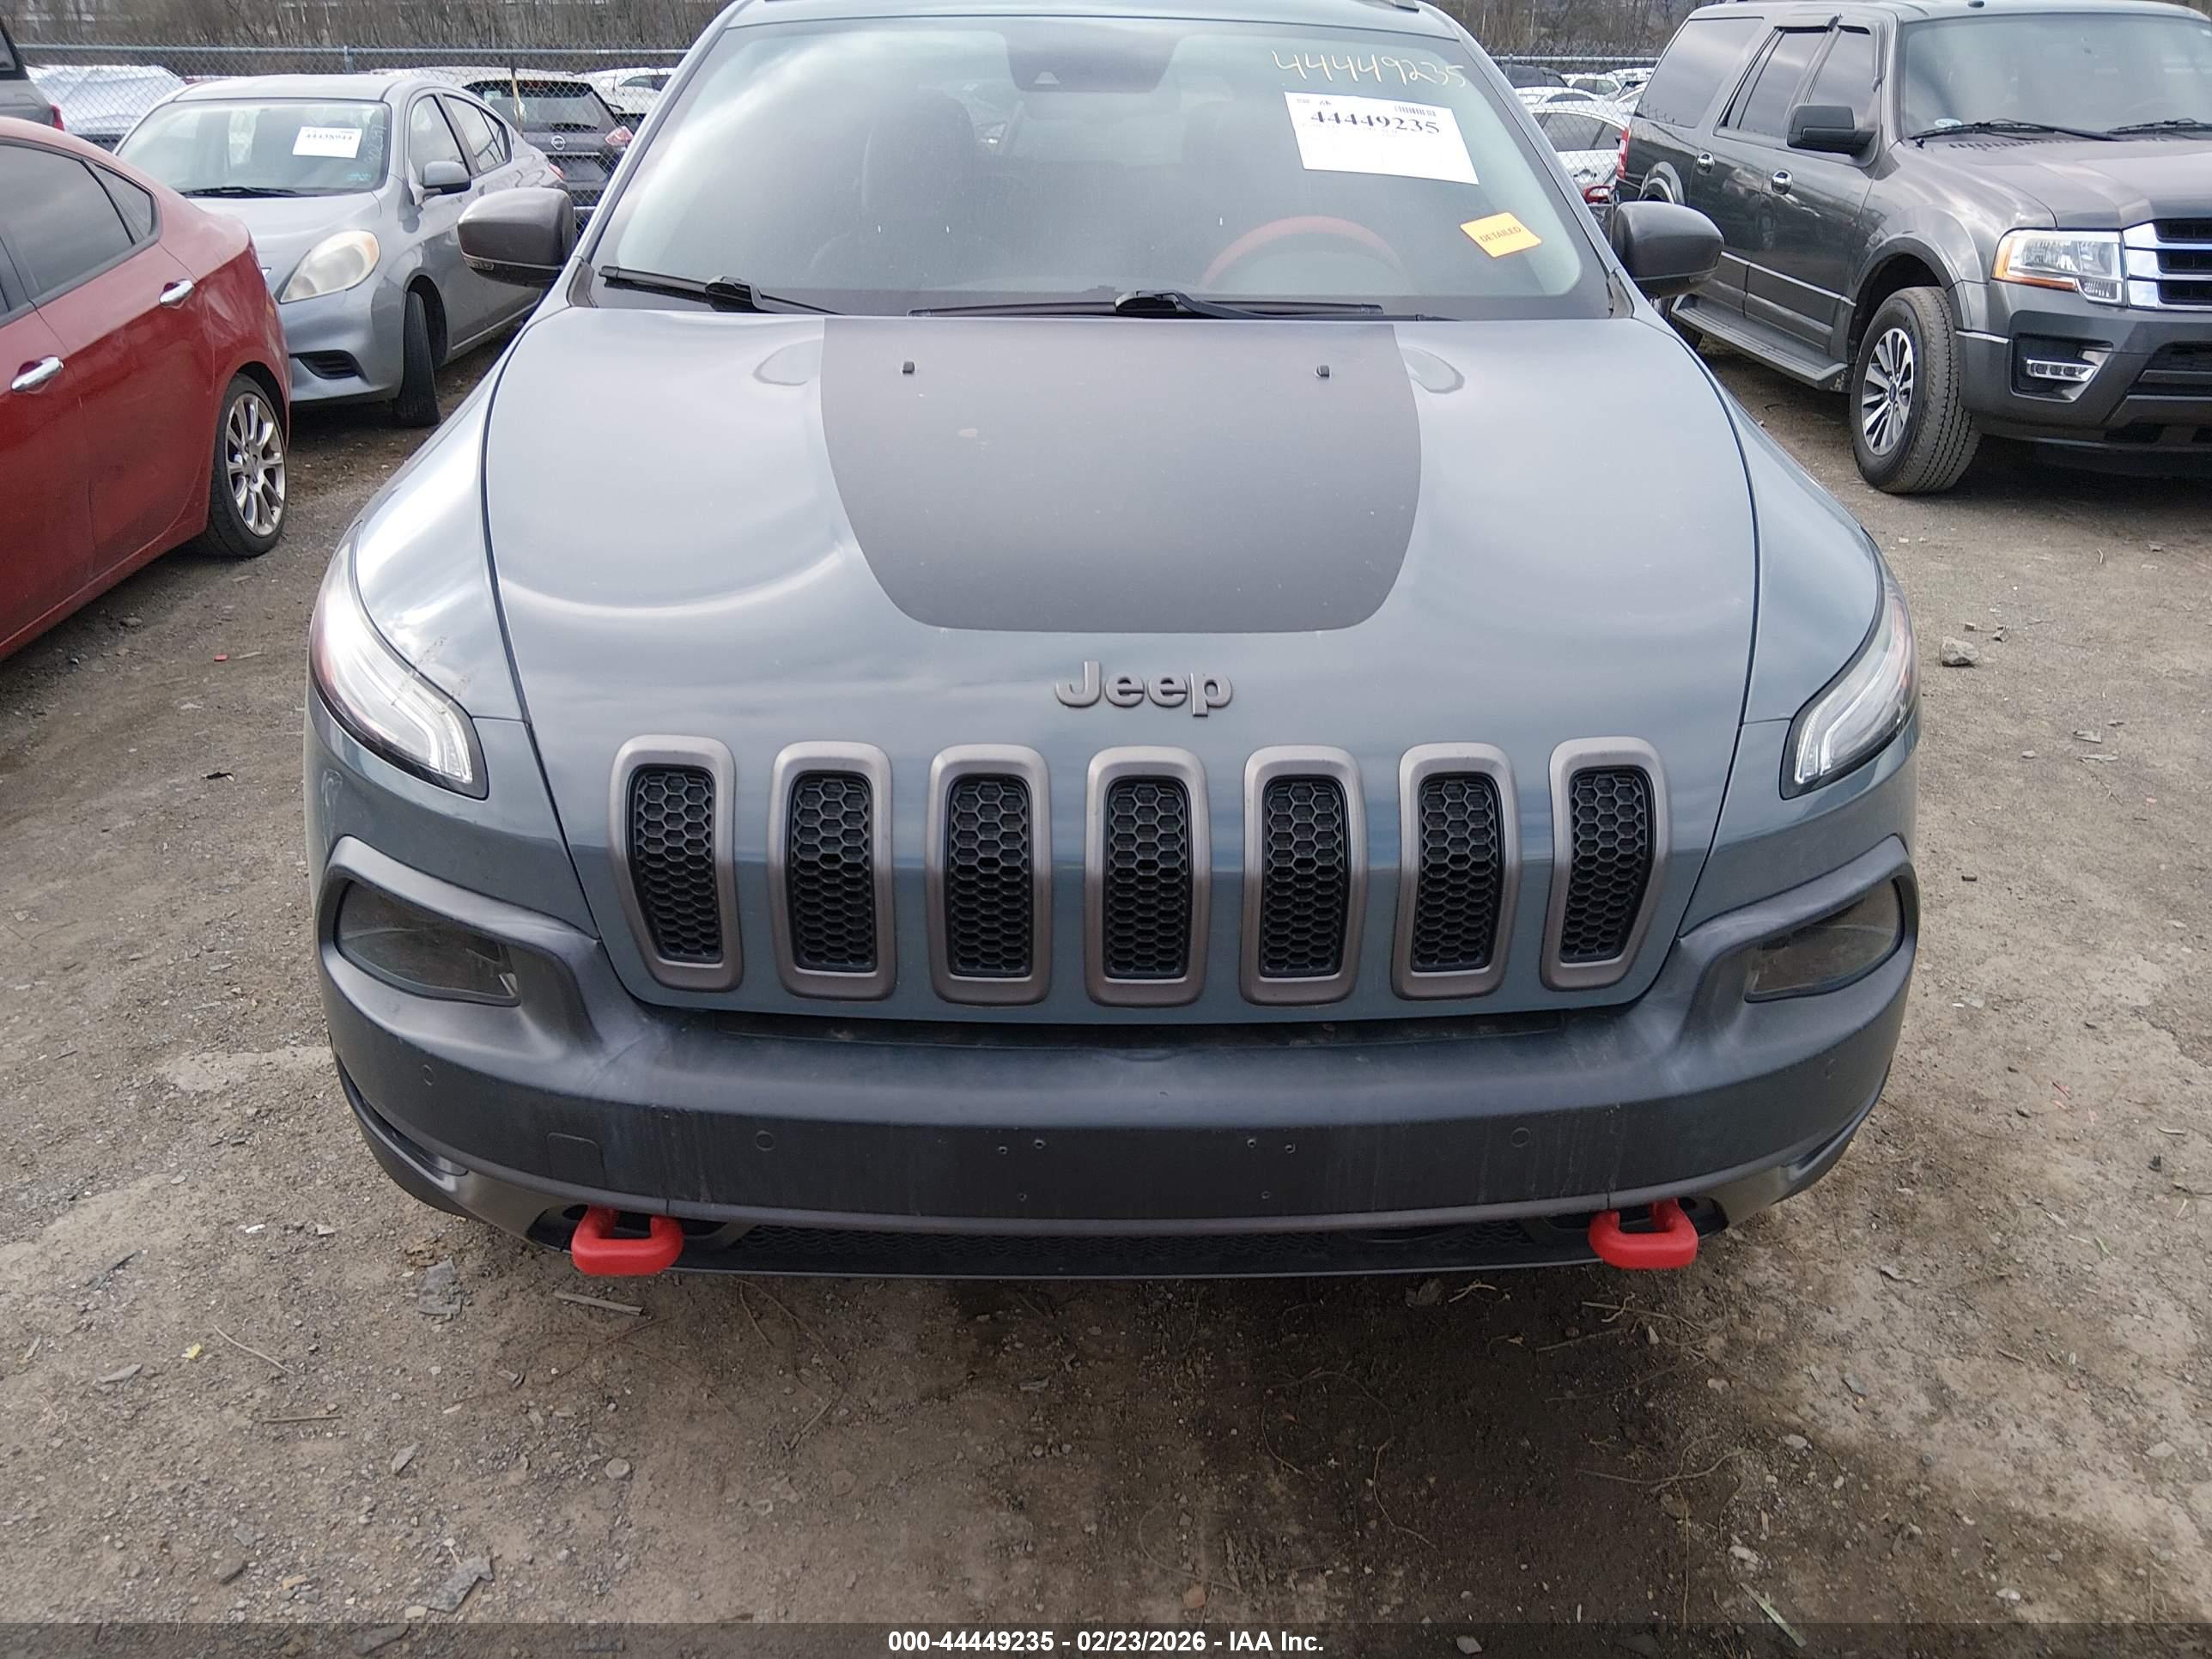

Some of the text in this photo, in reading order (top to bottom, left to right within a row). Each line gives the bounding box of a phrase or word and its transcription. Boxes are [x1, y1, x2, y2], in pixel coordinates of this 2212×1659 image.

[1271, 49, 1467, 88] 44449235
[1310, 111, 1440, 134] 44449235
[1479, 226, 1522, 242] DETAILED
[1054, 660, 1232, 717] Jeep
